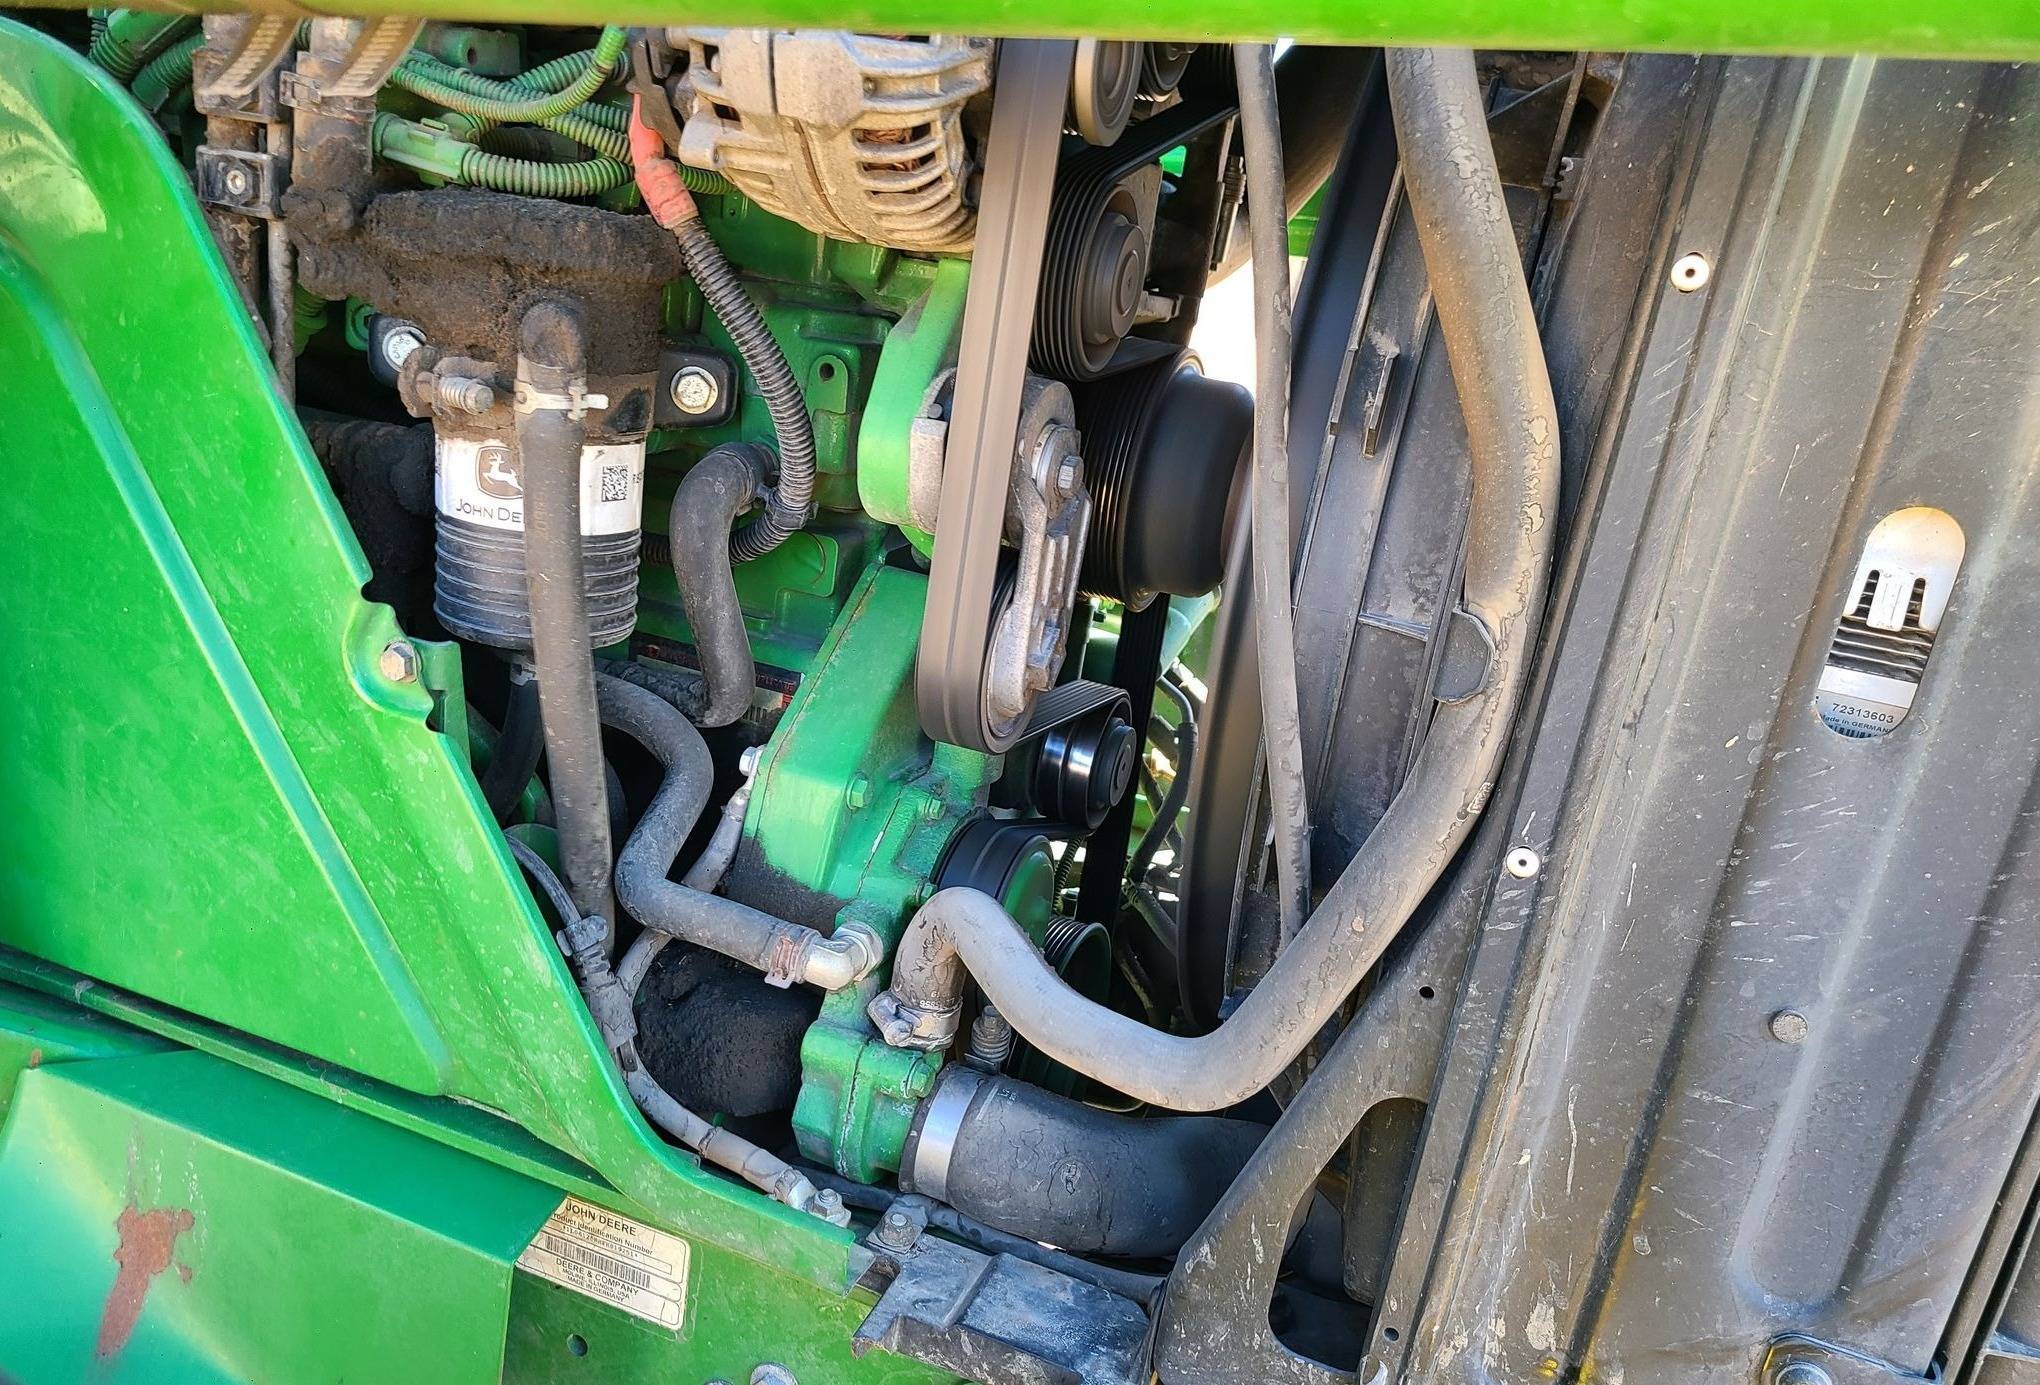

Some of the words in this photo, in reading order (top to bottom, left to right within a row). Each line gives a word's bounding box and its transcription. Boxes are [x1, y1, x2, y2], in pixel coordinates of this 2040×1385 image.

[456, 498, 493, 519] JOHN
[497, 507, 522, 523] DE
[1832, 702, 1895, 724] 72313603
[565, 1201, 596, 1221] JOHN
[598, 1214, 637, 1237] DEERE
[552, 1213, 577, 1226] roduct
[577, 1220, 623, 1244] Identification
[624, 1239, 654, 1255] Number
[556, 1257, 585, 1274] DEERE
[586, 1269, 593, 1279] &
[594, 1273, 639, 1296] COMPANY
[567, 1275, 585, 1287] MADE
[593, 1286, 624, 1302] GERMANY
[617, 1289, 630, 1299] USA
